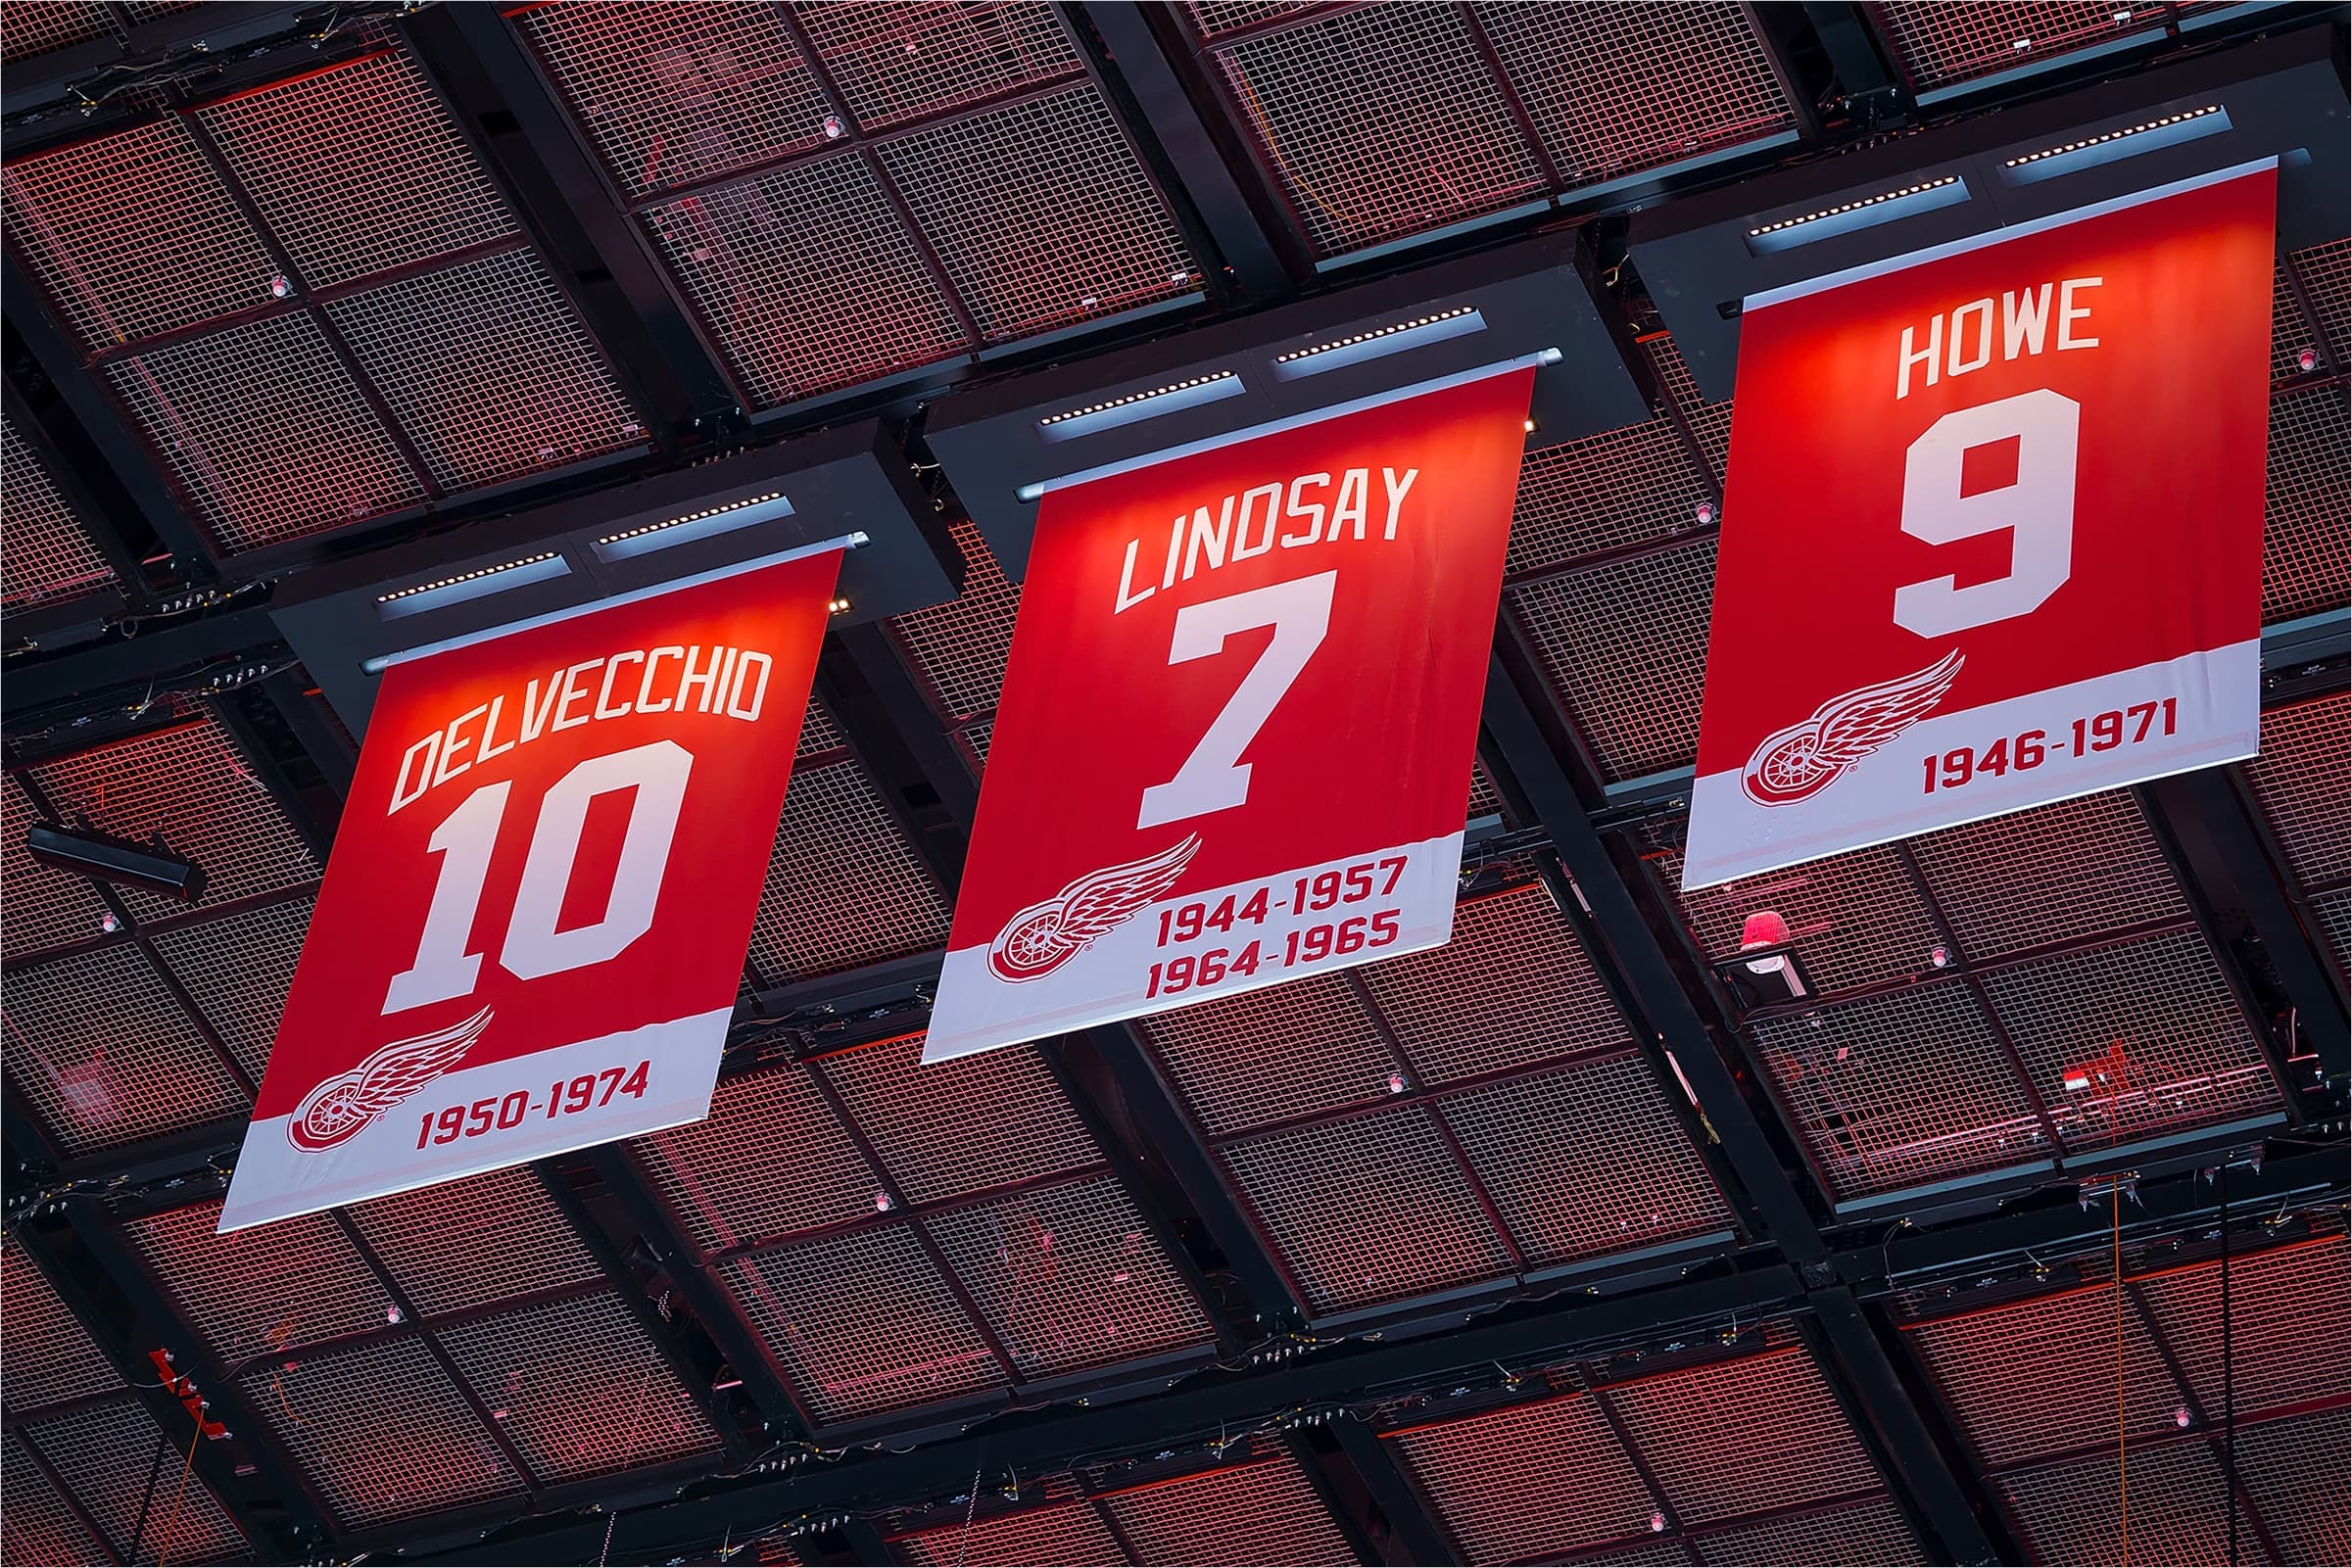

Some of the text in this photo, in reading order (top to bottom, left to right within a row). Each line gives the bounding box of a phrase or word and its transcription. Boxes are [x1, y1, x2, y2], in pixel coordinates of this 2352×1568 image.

[1896, 276, 2104, 400] HOWE
[1114, 466, 1419, 615] LINDSAY
[1893, 388, 2081, 640] 9
[387, 645, 774, 817] DELVECCHIO
[1136, 569, 1338, 831] 7
[1921, 696, 2178, 794] 1946-1971
[380, 738, 695, 1017] 10
[1156, 854, 1409, 948] 1944-1957
[1145, 908, 1402, 1000] 1964-1965
[415, 1060, 648, 1150] 1950-1974
